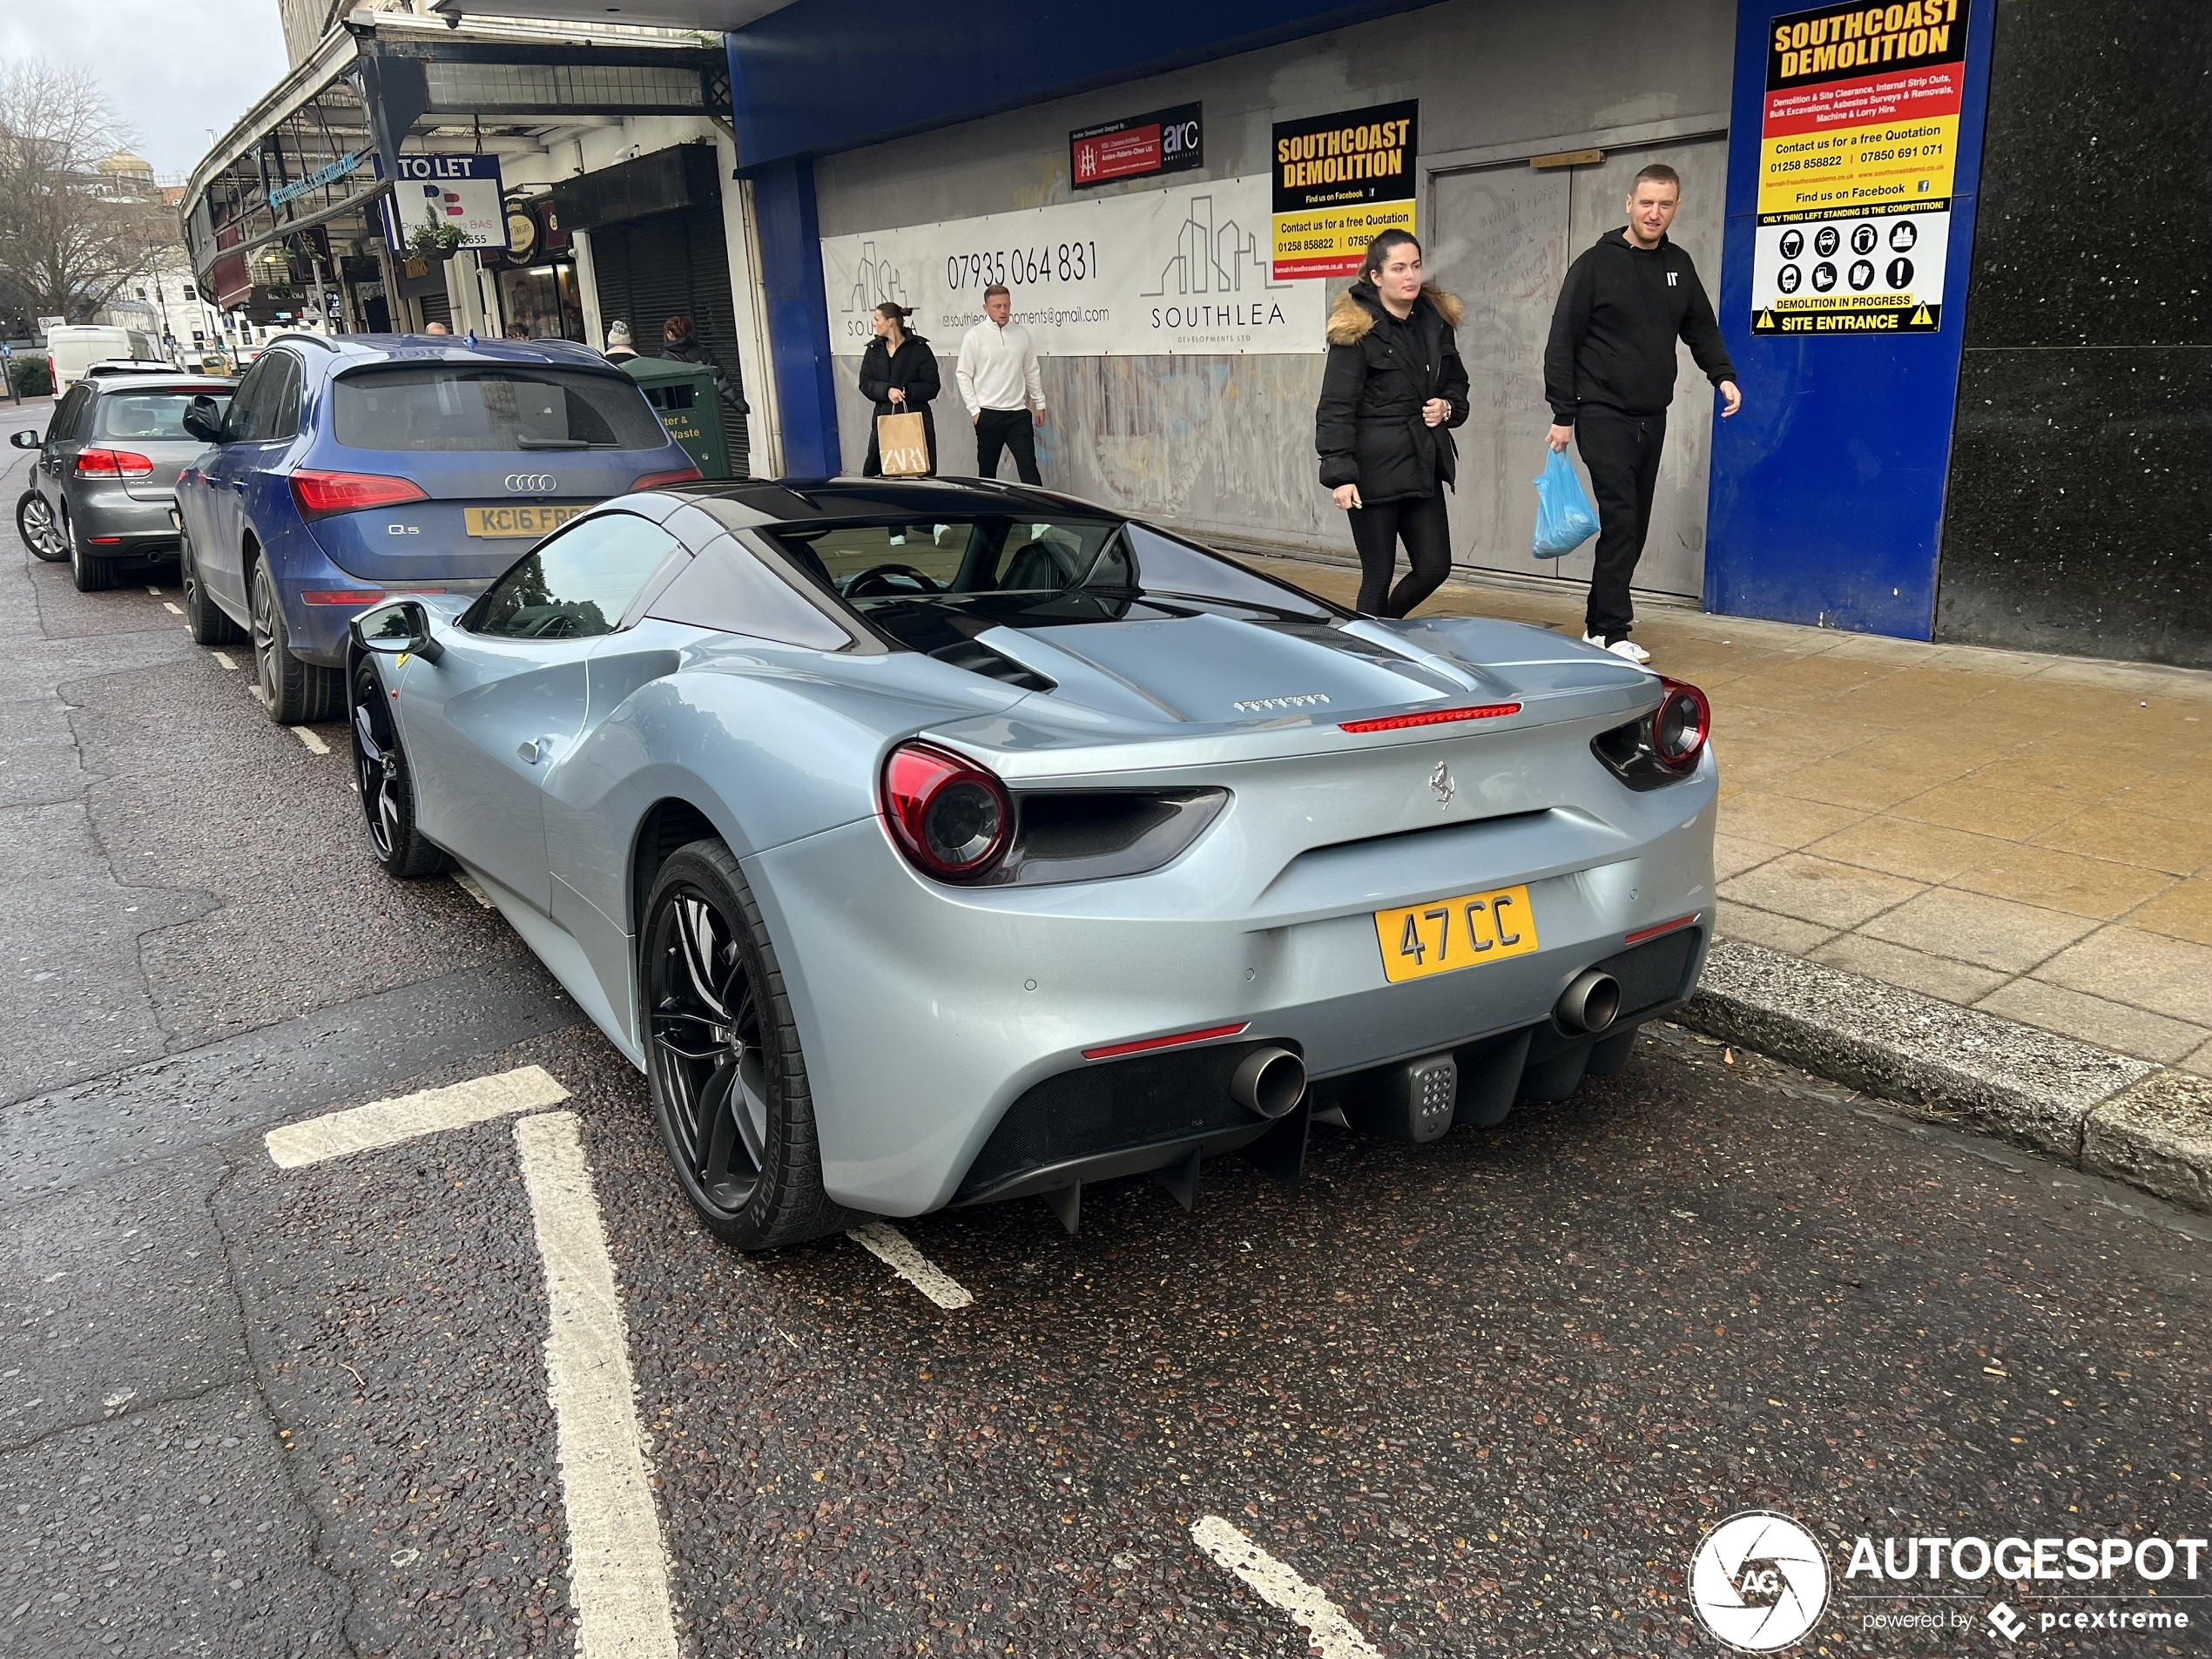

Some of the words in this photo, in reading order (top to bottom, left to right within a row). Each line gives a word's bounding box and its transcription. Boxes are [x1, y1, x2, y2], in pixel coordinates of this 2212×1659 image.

[1775, 0, 1959, 52] SOUTHCOAST
[1780, 24, 1950, 78] DEMOLITION
[1770, 109, 1785, 118] Bulk
[1787, 103, 1831, 116] Excavations,
[1833, 98, 1868, 110] Asbestos
[1870, 93, 1901, 105] Surveys
[1904, 91, 1909, 99] &
[1912, 85, 1953, 98] Removals,
[1773, 96, 1811, 107] Demolition
[1812, 93, 1817, 102] &
[1819, 91, 1834, 100] Site
[1835, 85, 1875, 98] Clearance,
[1877, 80, 1906, 91] Internal
[1908, 78, 1927, 87] Strip
[1929, 74, 1951, 84] Outs,
[1816, 112, 1847, 123] Machine
[1849, 110, 1855, 118] &
[1856, 108, 1877, 118] Lorry
[1878, 105, 1897, 114] Hire.
[1278, 118, 1411, 163] SOUTHCOAST
[1776, 140, 1815, 155] Contact
[1817, 139, 1830, 149] us
[1832, 137, 1848, 147] for
[1851, 137, 1857, 145] a
[1860, 132, 1882, 145] free
[1885, 125, 1941, 142] Quotation
[398, 158, 431, 178] TO
[435, 158, 474, 177] LET
[1283, 148, 1402, 188] DEMOLITION
[1770, 160, 1801, 173] 01258
[1804, 155, 1842, 170] 858822
[1860, 149, 1895, 163] 07850
[1898, 146, 1918, 158] 691
[1922, 144, 1943, 156] 071
[1765, 173, 1854, 188] hannah@southcoastdemo.co.uk
[1858, 164, 1945, 179] www.southcoastdemo.co.uk
[1335, 189, 1363, 200] Facebook
[1796, 191, 1818, 203] Find
[1821, 192, 1832, 201] us
[1836, 191, 1849, 199] on
[1851, 183, 1905, 198] Facebook
[470, 220, 493, 229] BAS
[1281, 220, 1312, 233] Contact
[1325, 219, 1337, 229] for
[1346, 217, 1364, 227] free
[1366, 212, 1409, 226] Quotation
[1763, 215, 1782, 224] ONLY
[1783, 213, 1804, 222] THING
[1804, 212, 1822, 220] LEFT
[1824, 208, 1860, 219] STANDING
[1862, 207, 1870, 216] IS
[1871, 206, 1886, 214] THE
[1887, 201, 1944, 213] COMPETITION!
[1278, 240, 1302, 253] 01258
[1304, 238, 1333, 250] 858822
[1348, 234, 1374, 247] 07850
[948, 251, 1005, 291] 07935
[1011, 246, 1051, 286] 064
[1058, 240, 1096, 282] 831
[1777, 298, 1837, 310] DEMOLITION
[1839, 297, 1849, 307] IN
[1852, 295, 1911, 307] PROGRESS
[1151, 303, 1285, 328] SOUTHLEA
[1782, 316, 1814, 331] SITE
[1817, 314, 1899, 330] ENTRANCE
[681, 415, 688, 424] &
[880, 447, 927, 473] ZARA
[388, 524, 420, 535] Q5
[482, 509, 534, 531] KC16
[1399, 907, 1449, 966] 47
[1464, 894, 1521, 953] CC
[760, 1113, 782, 1207] MICHELIN
